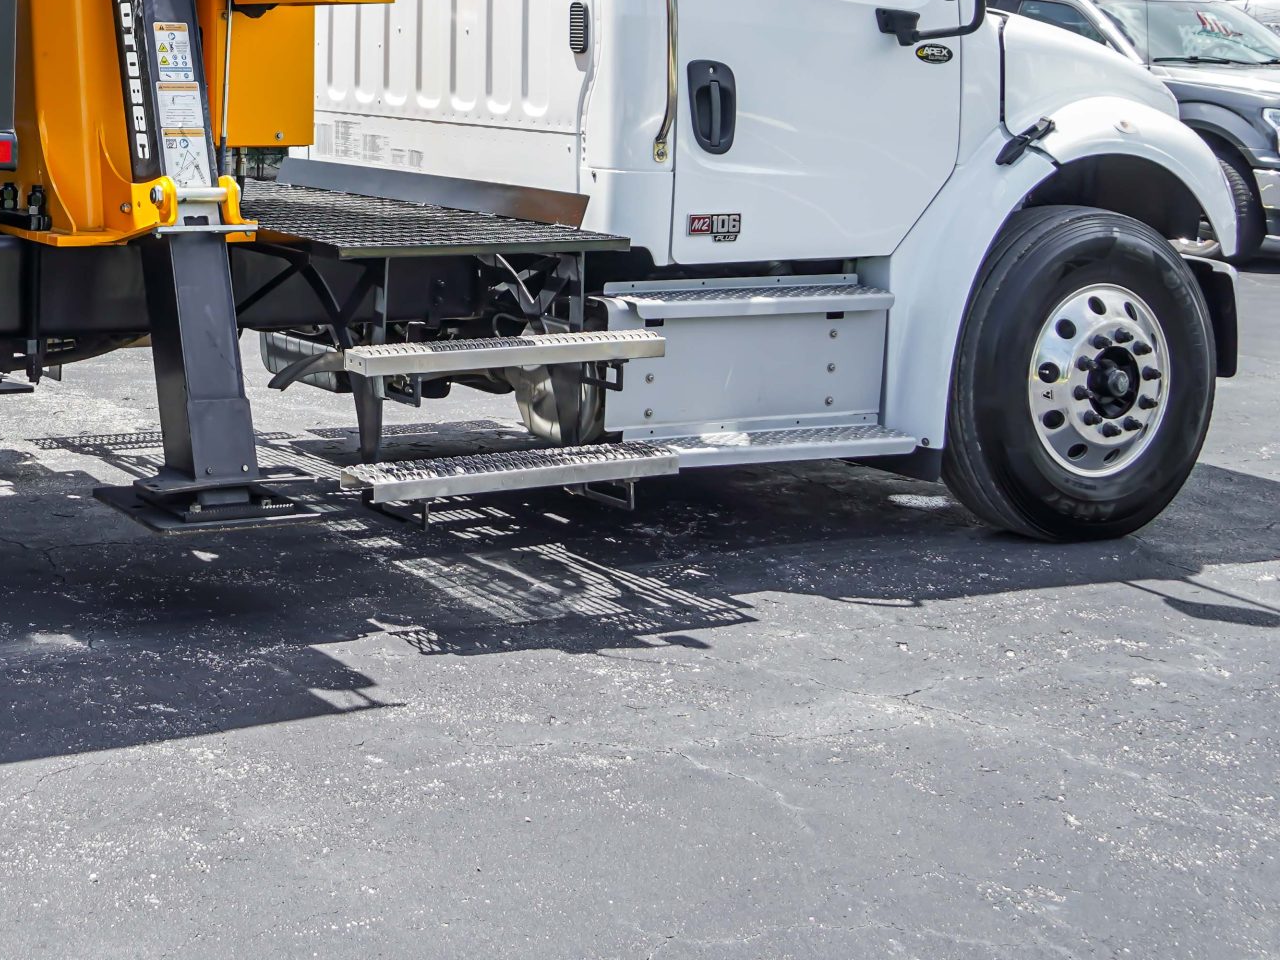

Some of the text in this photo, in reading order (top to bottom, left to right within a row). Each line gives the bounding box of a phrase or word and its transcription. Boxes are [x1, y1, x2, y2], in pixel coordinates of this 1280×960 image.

[923, 46, 948, 56] APEX
[692, 215, 739, 232] M2 106
